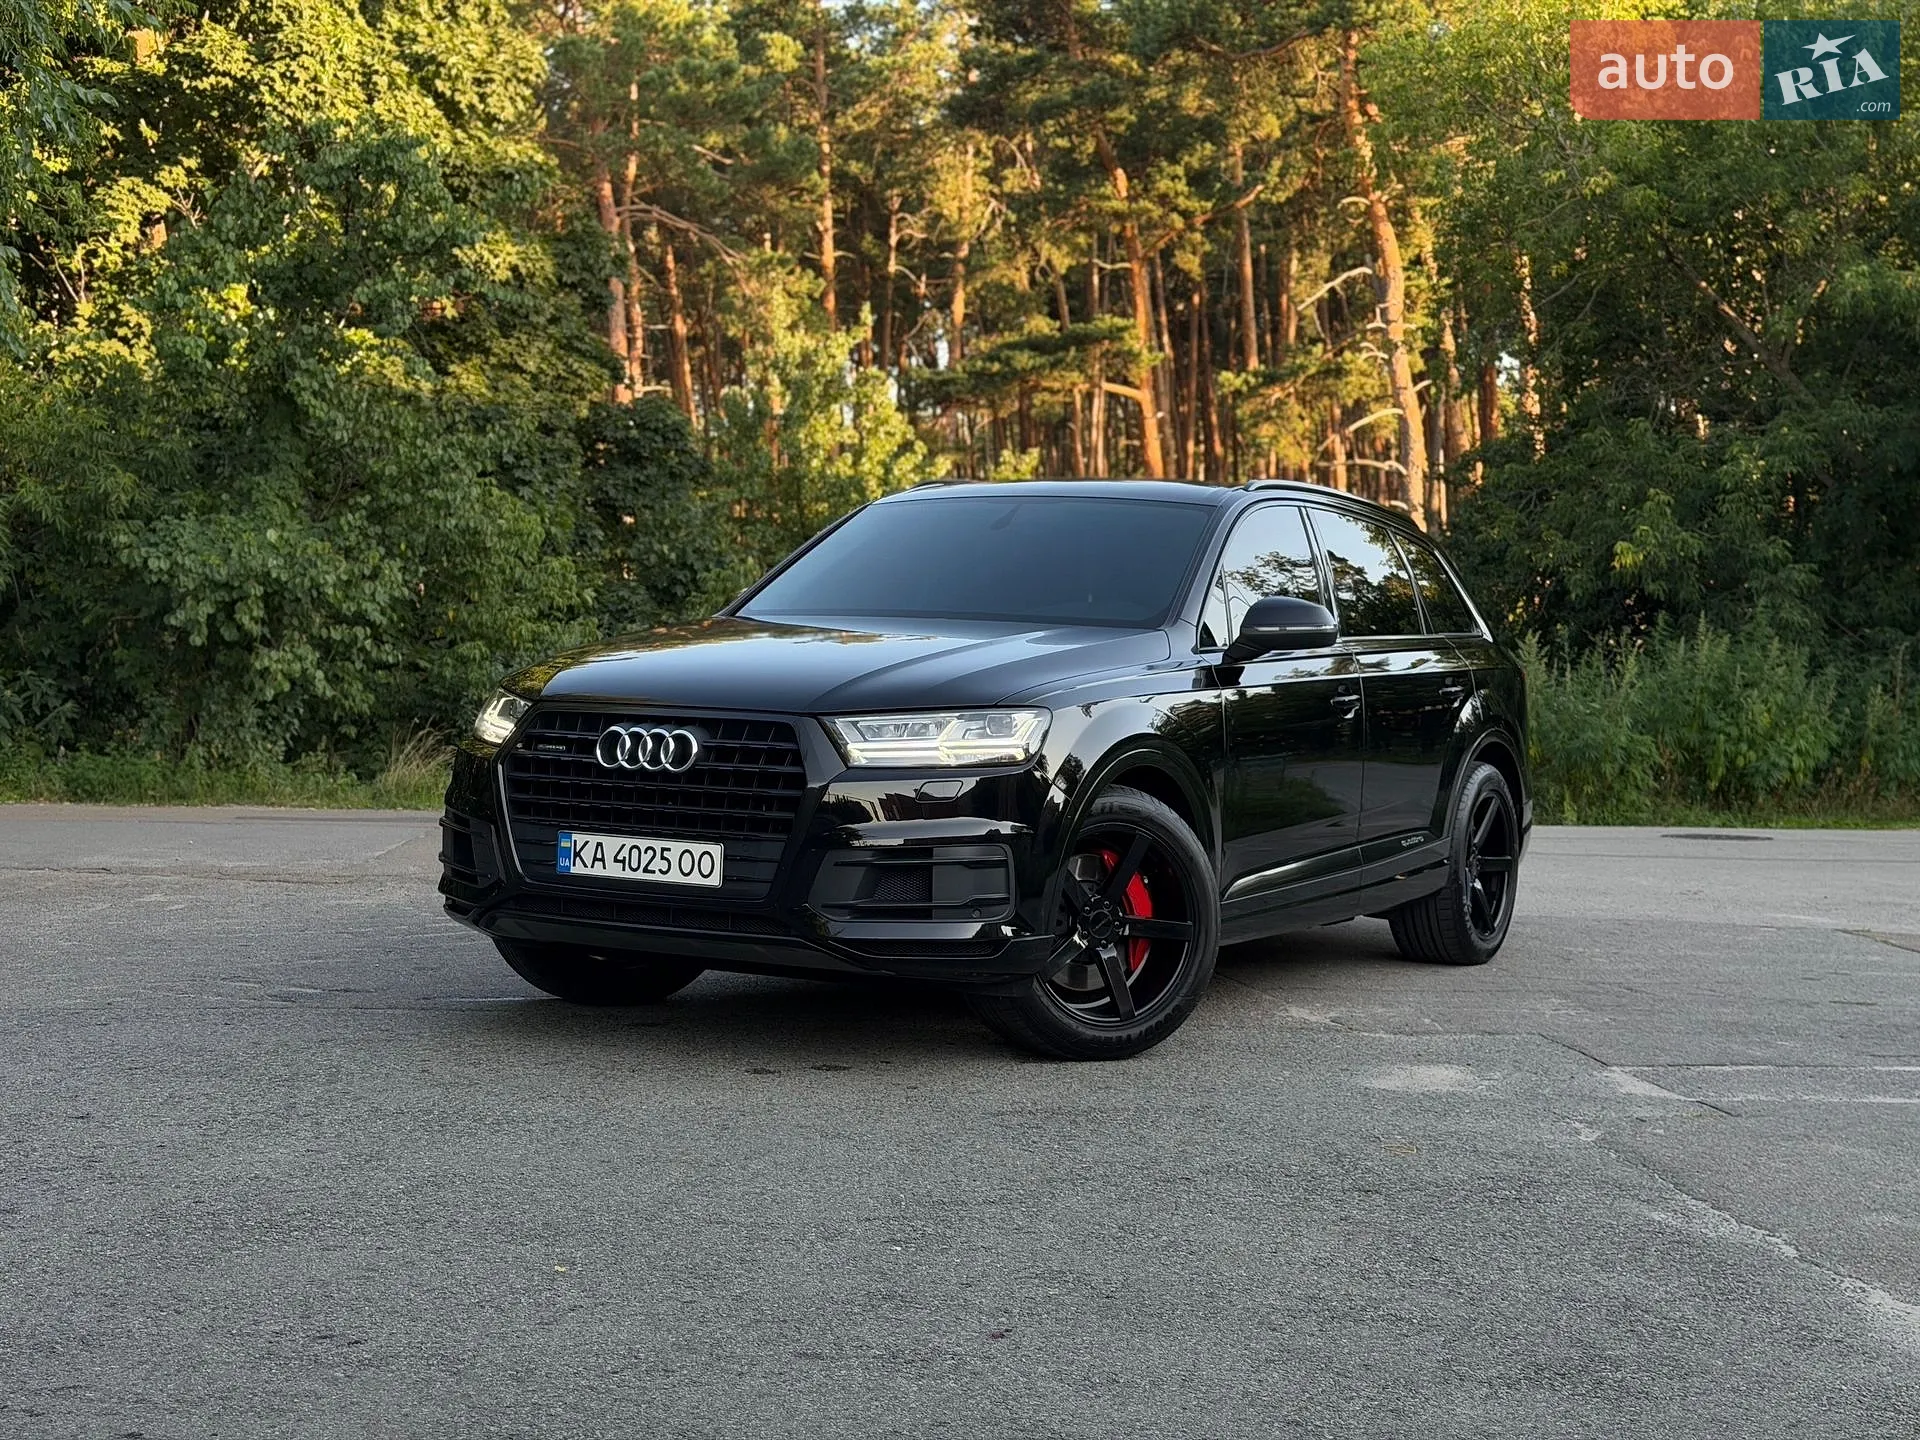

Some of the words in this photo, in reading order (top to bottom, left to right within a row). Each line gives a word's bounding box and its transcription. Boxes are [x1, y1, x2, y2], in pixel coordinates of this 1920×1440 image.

[559, 857, 570, 867] UA
[572, 839, 607, 870] KA
[613, 843, 672, 875] 4025
[678, 849, 715, 879] OO
